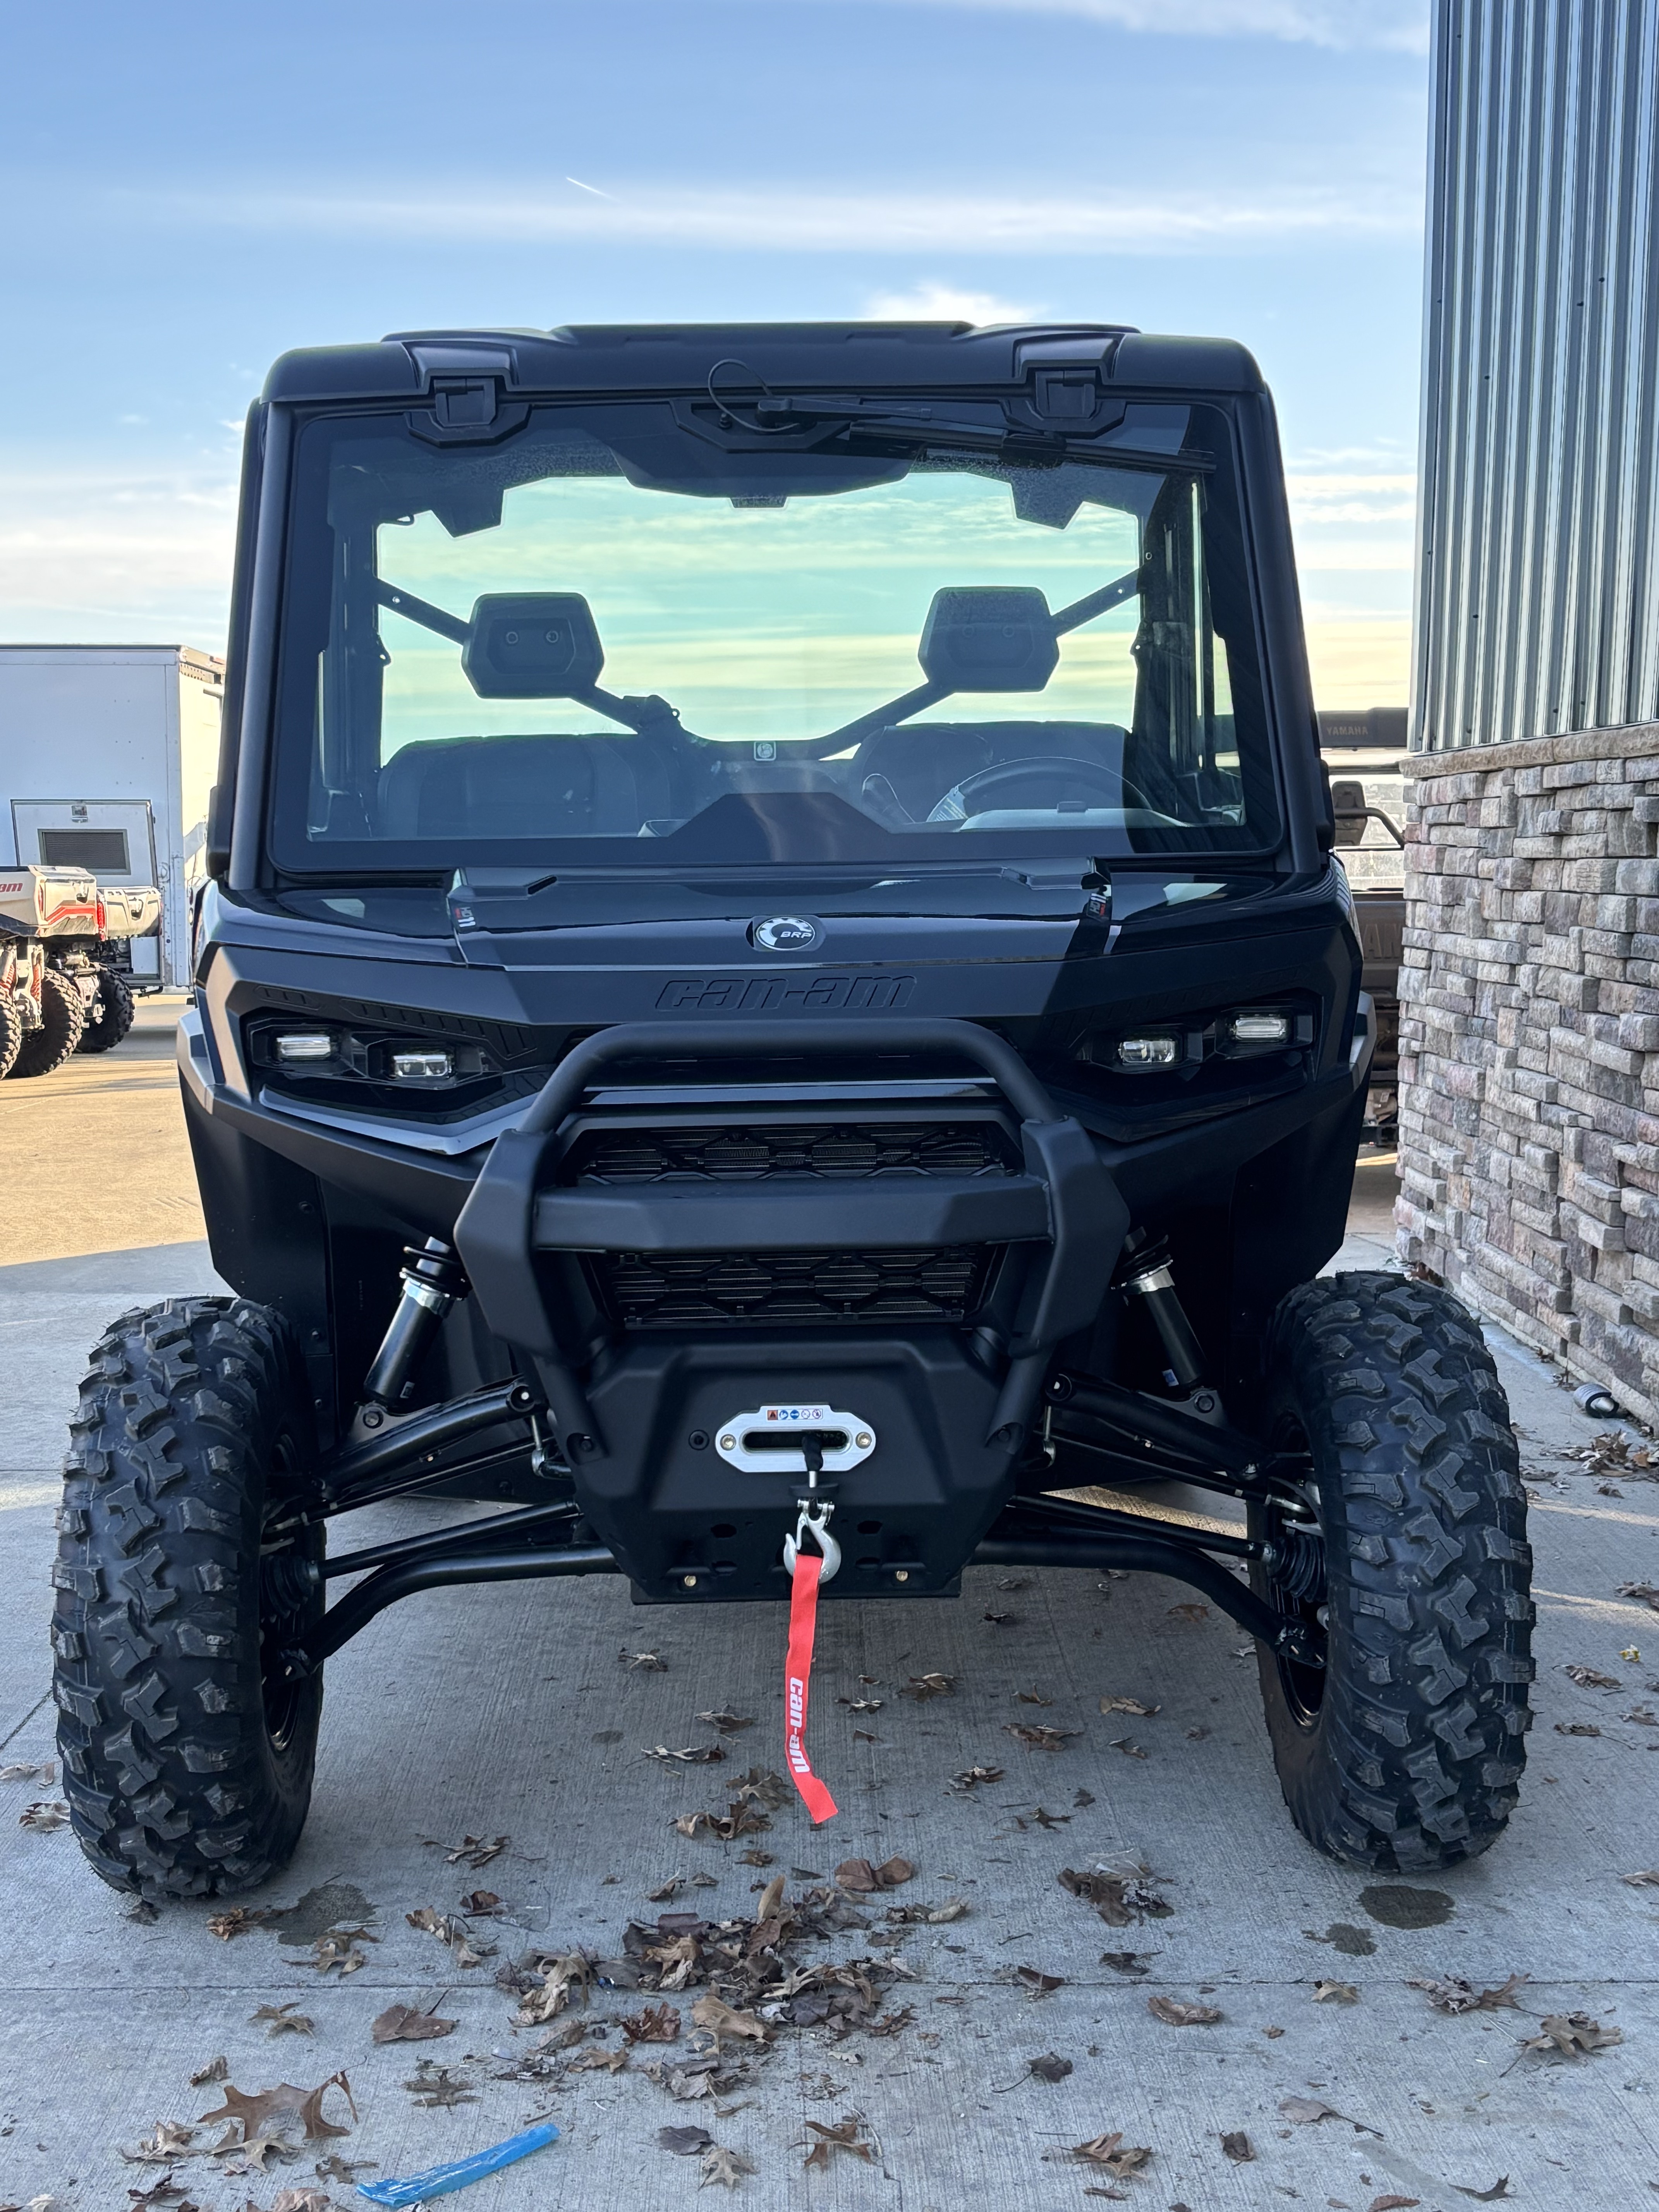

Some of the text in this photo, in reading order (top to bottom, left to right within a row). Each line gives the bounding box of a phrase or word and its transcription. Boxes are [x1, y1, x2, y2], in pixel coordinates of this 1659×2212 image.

[1326, 726, 1368, 735] YAMAHA
[655, 975, 917, 1012] can-am
[789, 1677, 810, 1773] can-am
